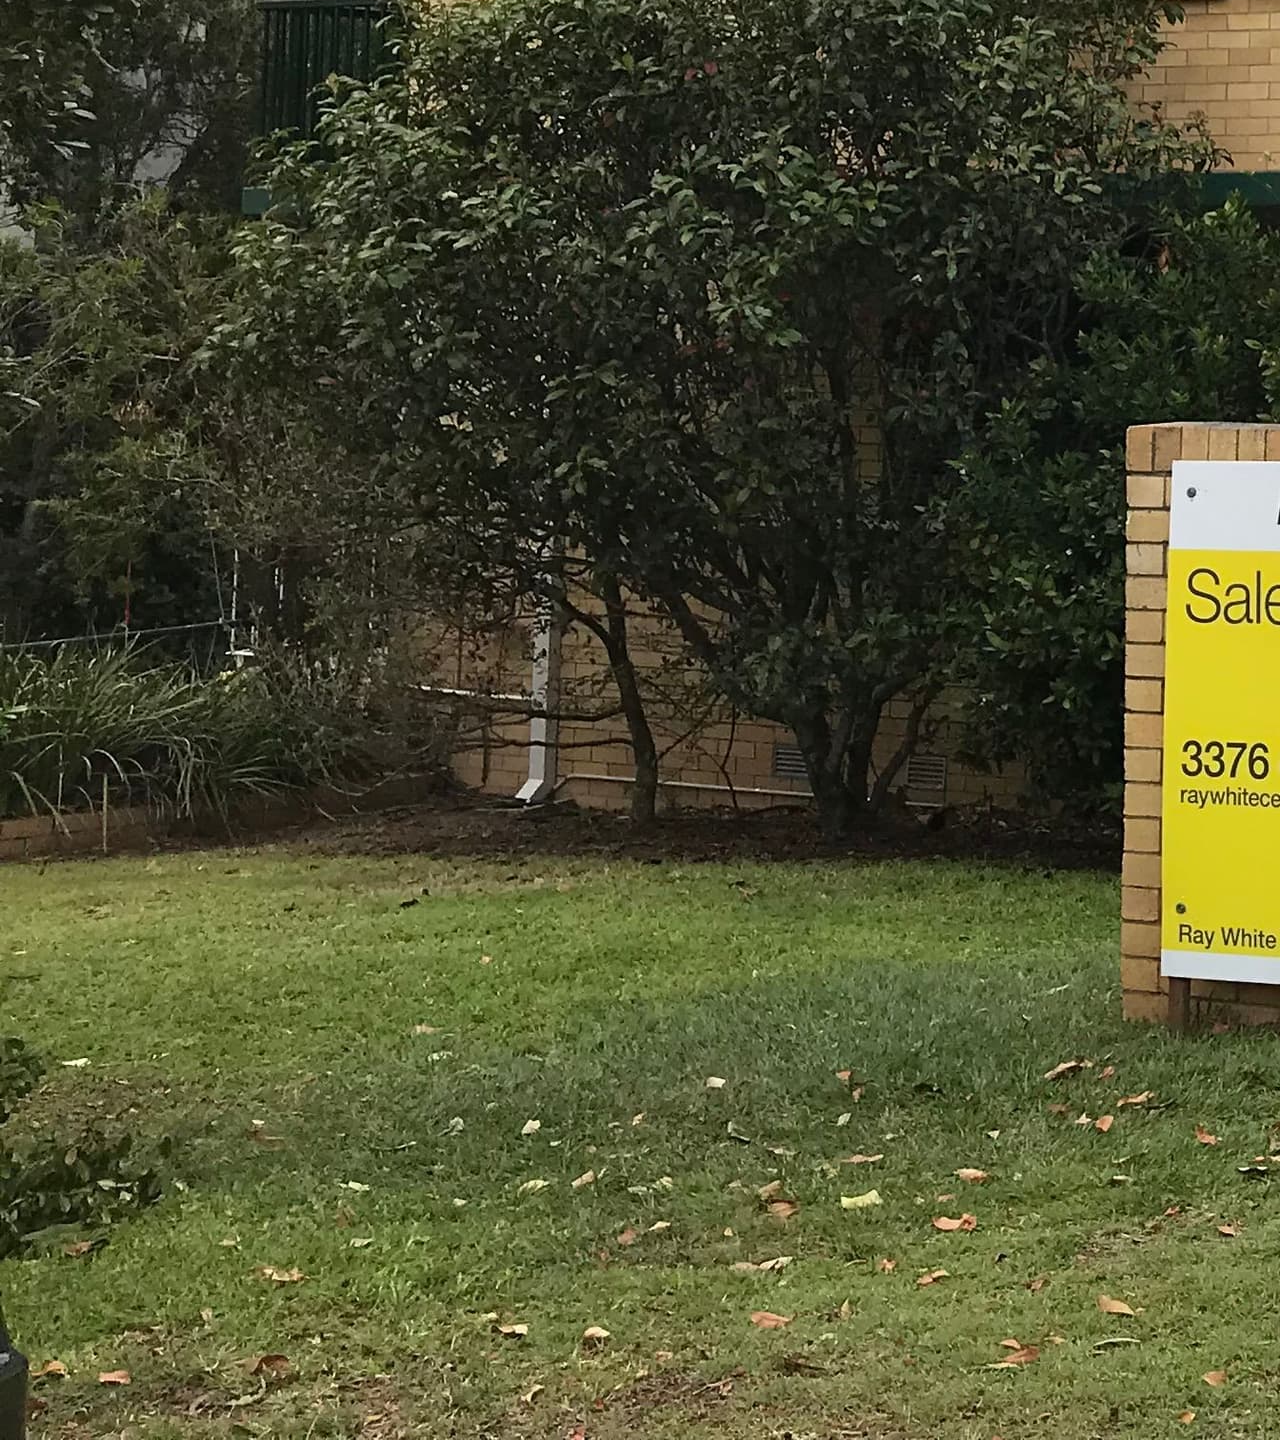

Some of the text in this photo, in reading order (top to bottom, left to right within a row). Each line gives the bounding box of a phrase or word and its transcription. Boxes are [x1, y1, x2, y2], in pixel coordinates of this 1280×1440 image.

[1180, 739, 1270, 781] 3376
[1178, 924, 1215, 949] Ray
[1221, 927, 1277, 951] White
